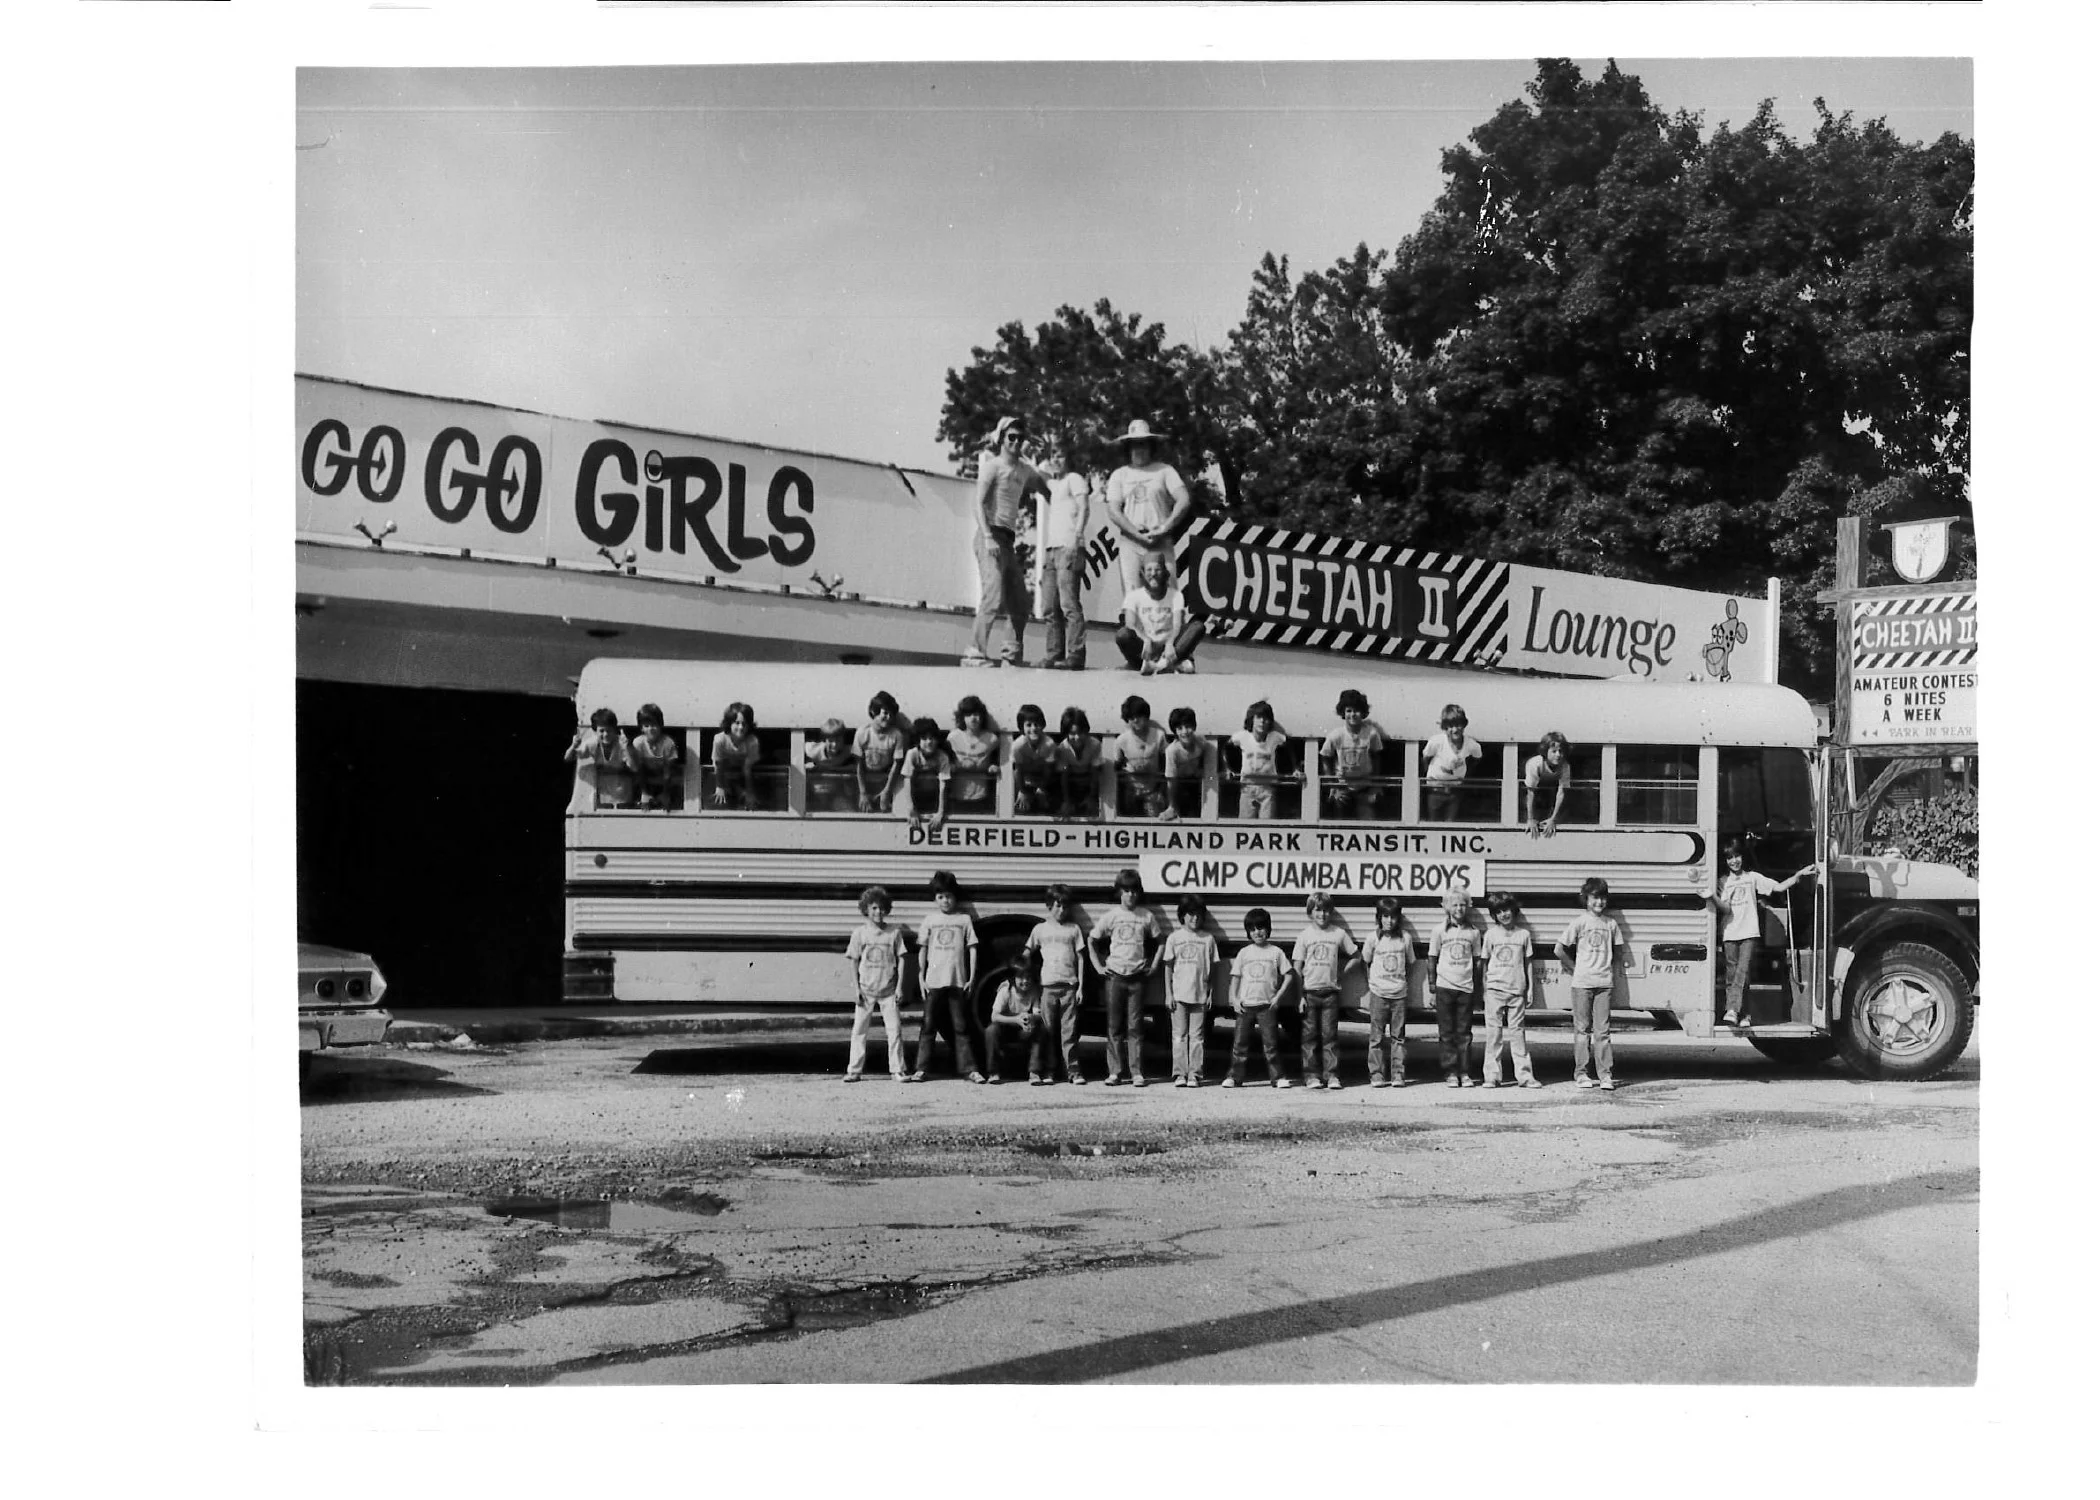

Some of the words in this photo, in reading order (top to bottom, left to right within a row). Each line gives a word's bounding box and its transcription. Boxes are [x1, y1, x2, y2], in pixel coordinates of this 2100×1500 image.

[302, 419, 406, 503] GO
[424, 427, 542, 533] GO
[1199, 546, 1393, 628] CHEETAH
[1419, 577, 1450, 638] II
[1523, 587, 1677, 676] Lounge
[1861, 617, 1951, 648] CHEETAH
[1957, 616, 1975, 644] II
[1854, 677, 1917, 691] AMATEUR
[1884, 694, 1892, 706] 6
[1904, 692, 1946, 705] NITES
[1883, 709, 1891, 722] A
[1904, 708, 1942, 721] WEEK
[1888, 728, 1919, 737] PARK
[1925, 727, 1937, 737] IN
[1941, 726, 1972, 736] REAR
[1235, 831, 1301, 852] PARK
[1440, 834, 1492, 853] INC.
[1161, 861, 1239, 889] CAMP
[1246, 862, 1351, 890] CUAMBA
[1359, 864, 1403, 891] FOR
[1410, 866, 1471, 893] BOYS
